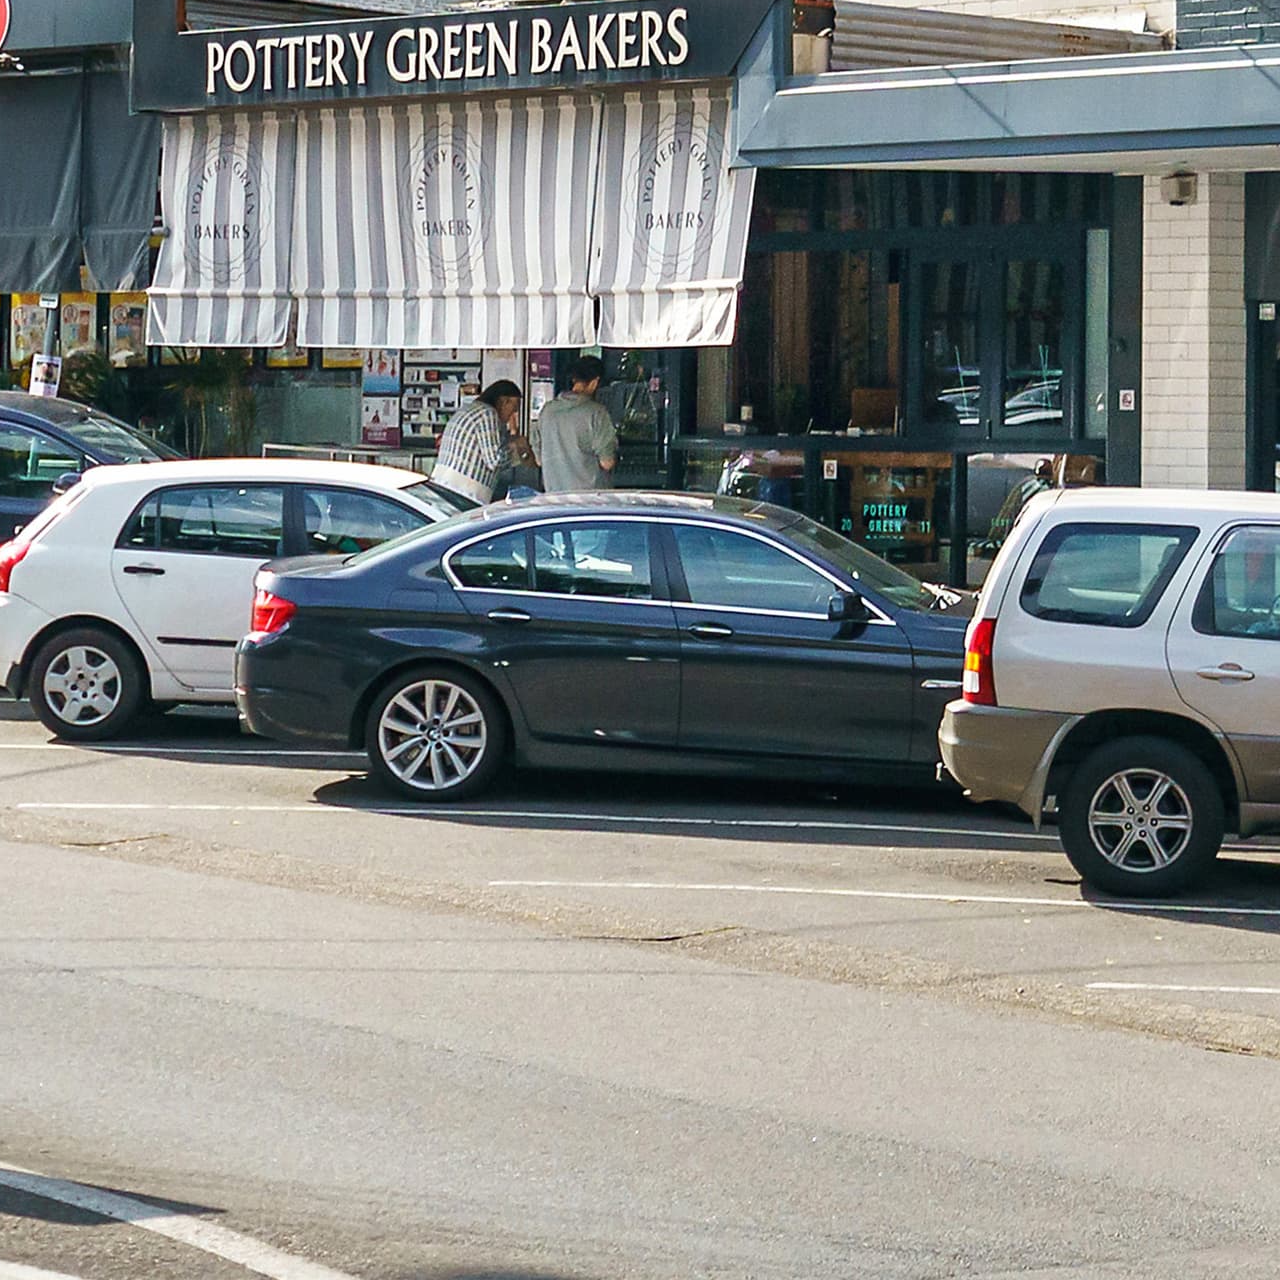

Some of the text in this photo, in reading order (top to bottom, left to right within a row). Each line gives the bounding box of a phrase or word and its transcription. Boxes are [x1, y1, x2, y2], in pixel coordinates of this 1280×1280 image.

[206, 8, 689, 94] POTTERY GREEN BAKERS
[422, 220, 472, 237] BAKERS
[645, 212, 703, 229] BAKERS
[194, 223, 250, 239] BAKERS
[863, 504, 907, 517] POTTERY
[841, 519, 931, 533] 20 GREEN 11
